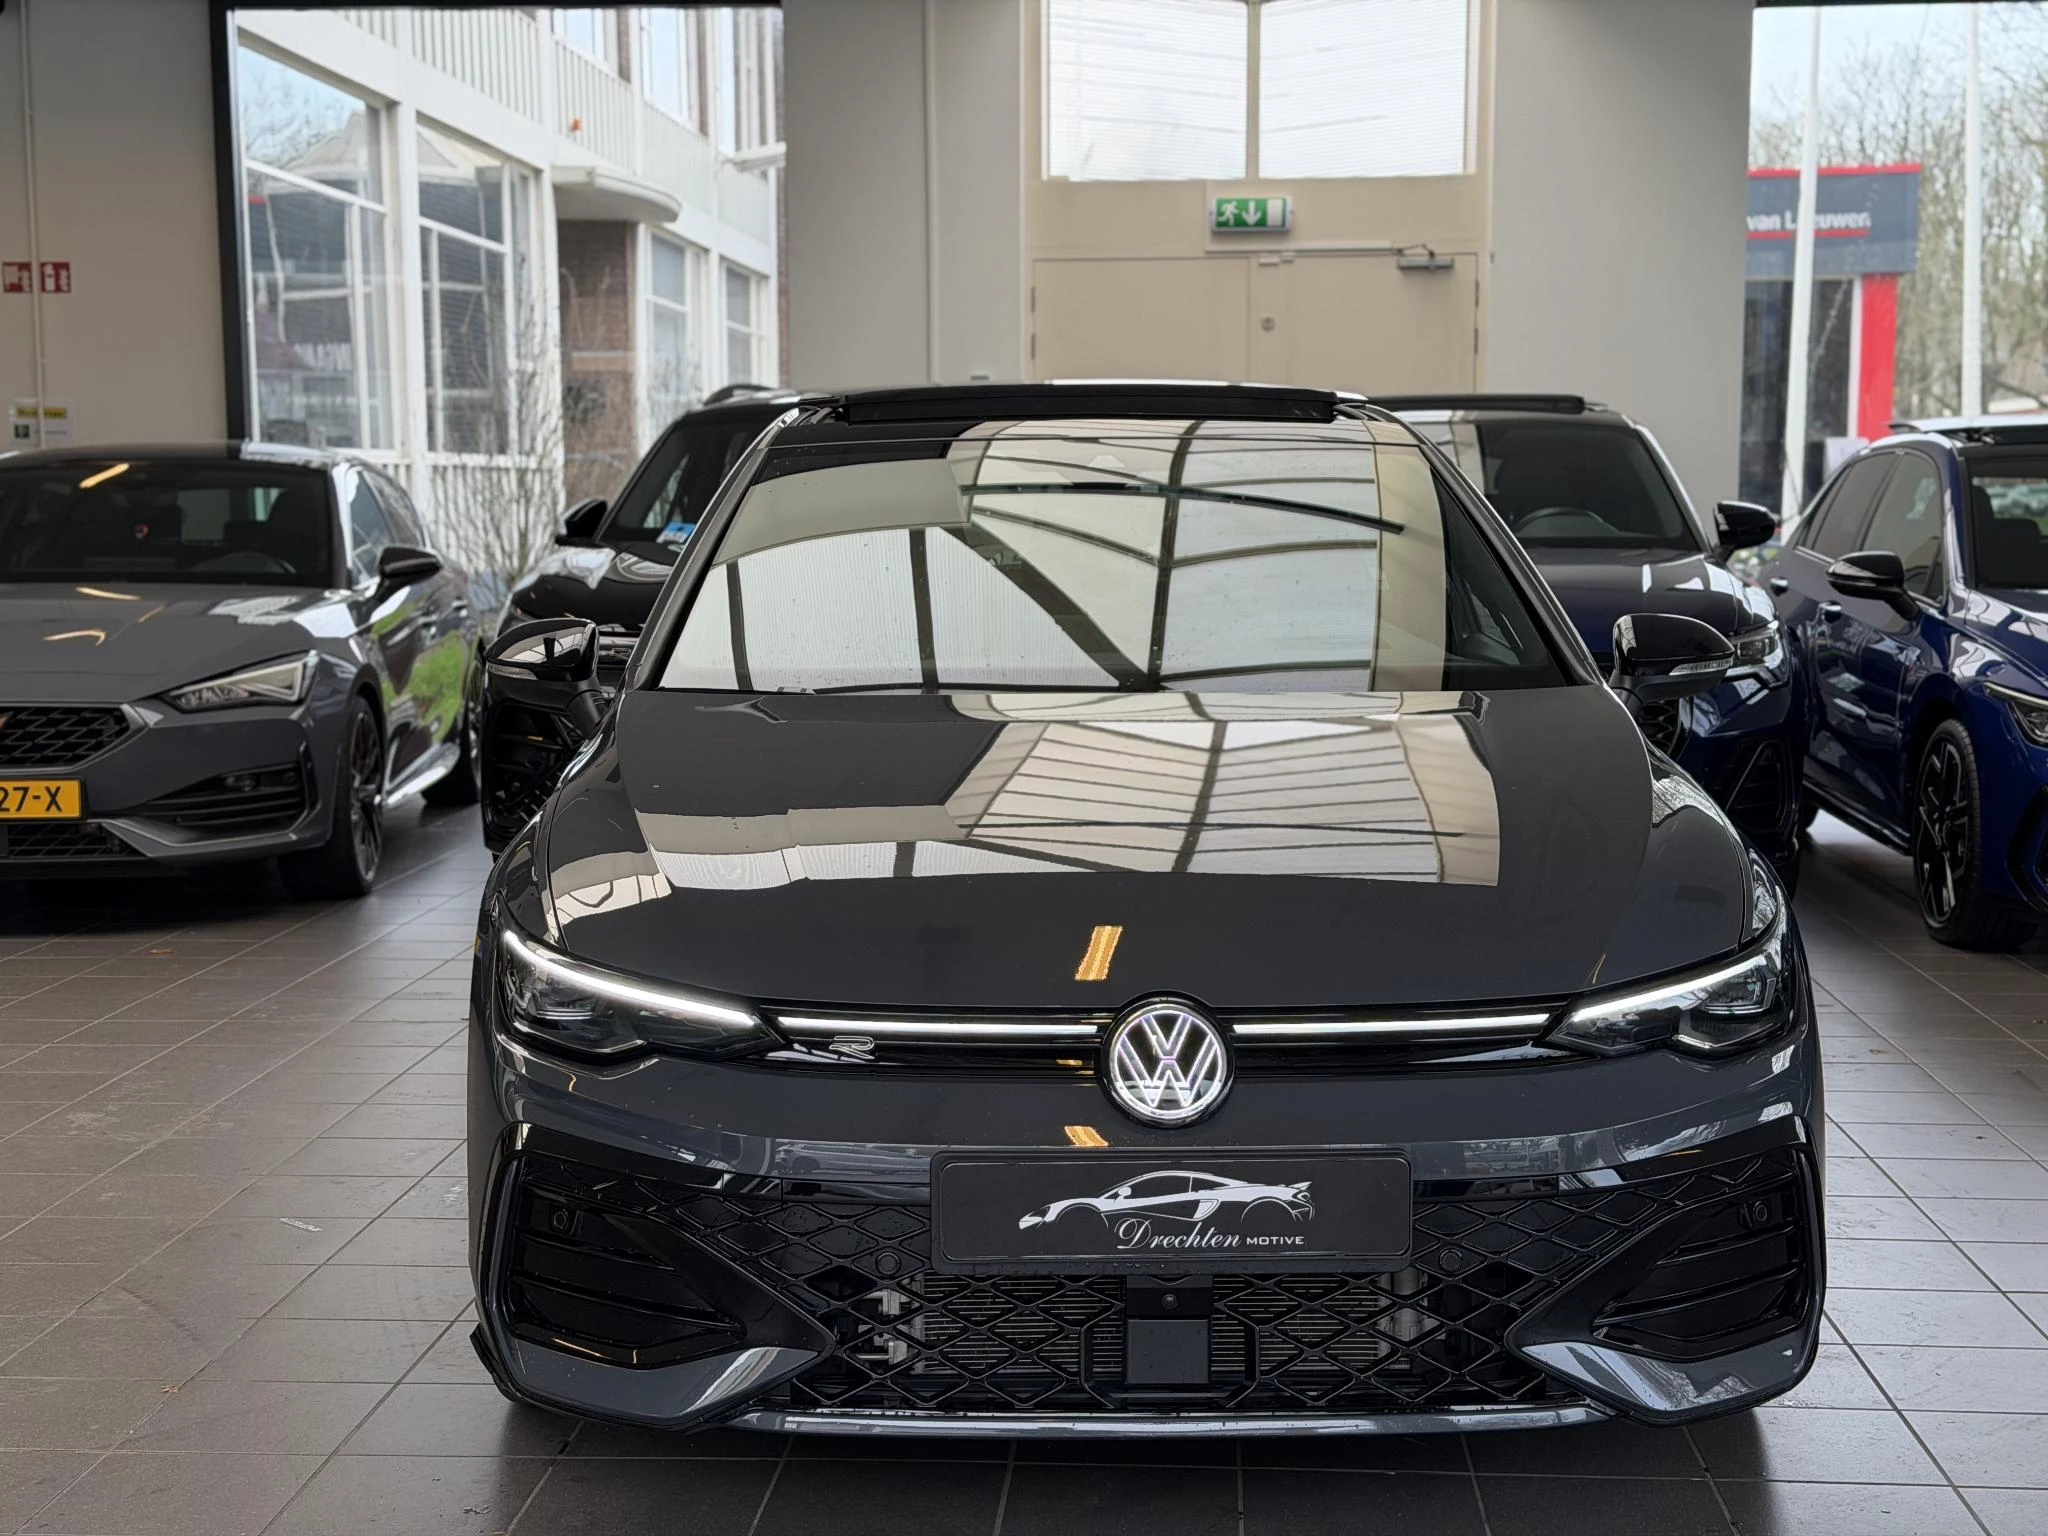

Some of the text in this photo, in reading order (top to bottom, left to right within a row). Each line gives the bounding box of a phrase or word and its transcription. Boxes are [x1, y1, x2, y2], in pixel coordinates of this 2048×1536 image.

[1746, 210, 1871, 230] van Leuwen
[1114, 1217, 1304, 1249] Drechten MOTIVE
